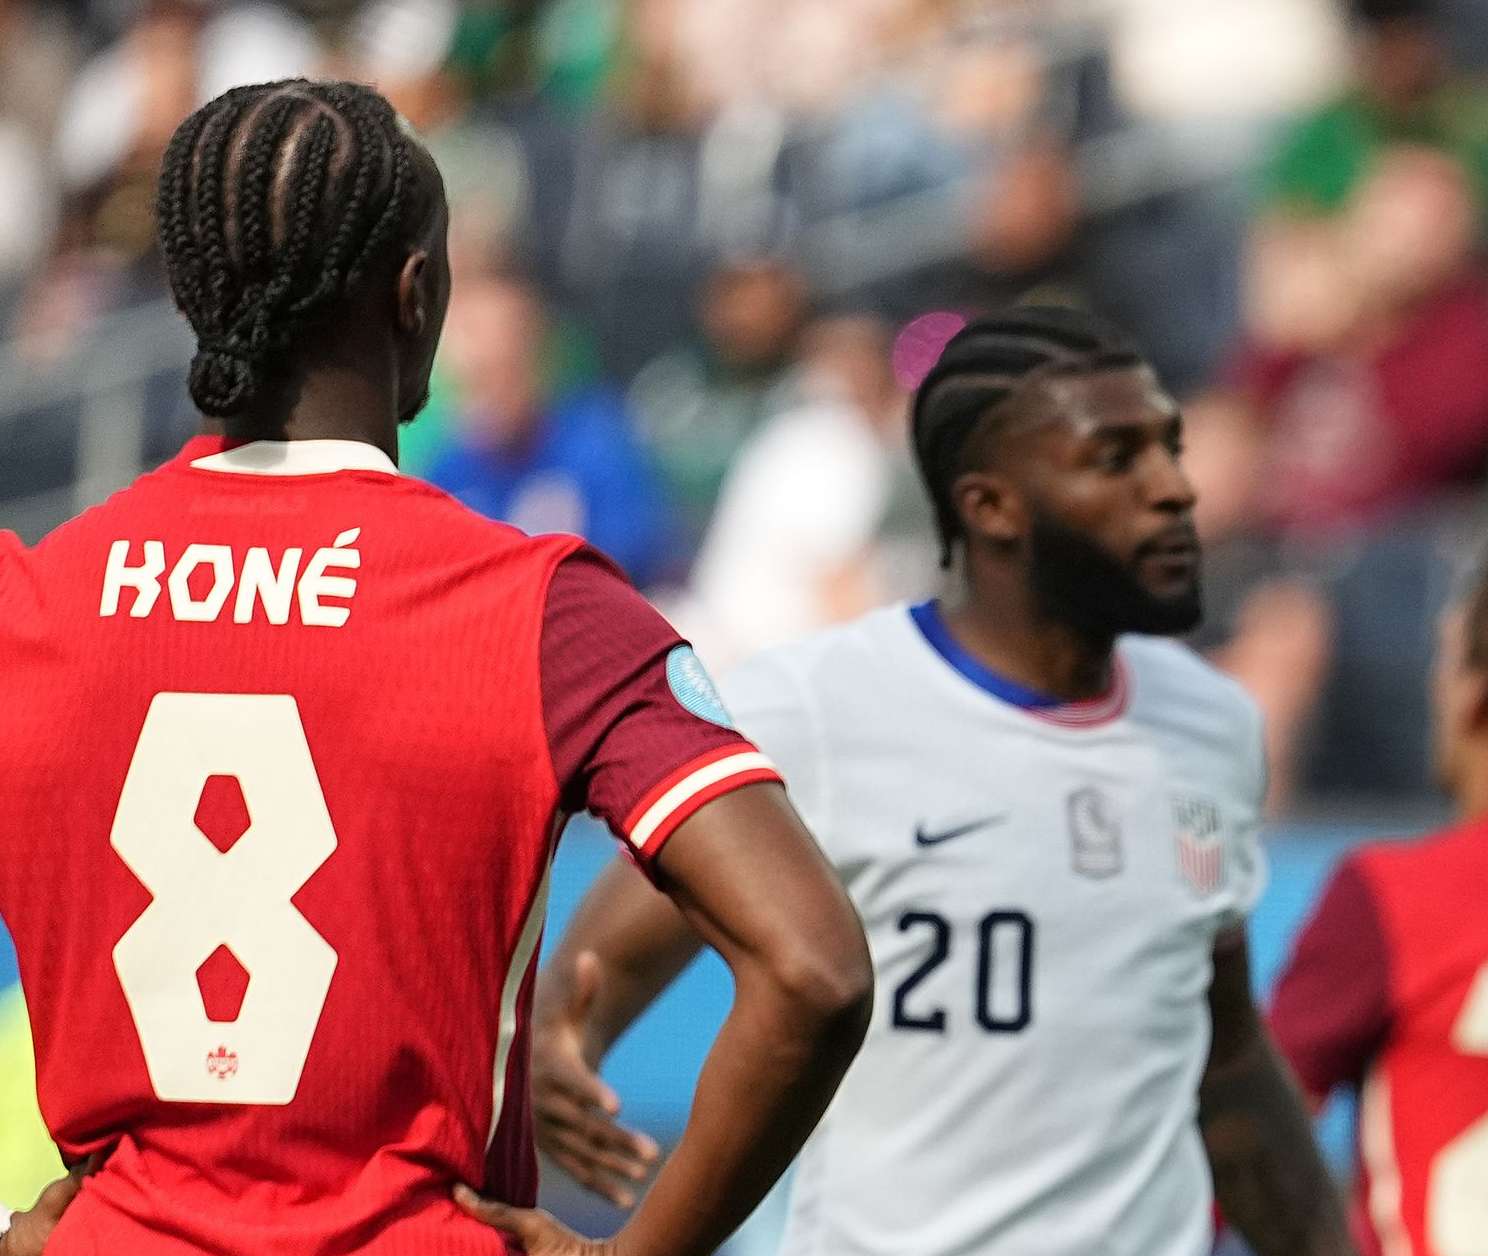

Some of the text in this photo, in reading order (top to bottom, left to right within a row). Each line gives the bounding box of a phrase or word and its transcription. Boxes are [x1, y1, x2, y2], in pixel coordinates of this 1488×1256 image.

[99, 527, 361, 627] KONÉ
[109, 692, 339, 1105] 8
[893, 911, 1033, 1034] 20
